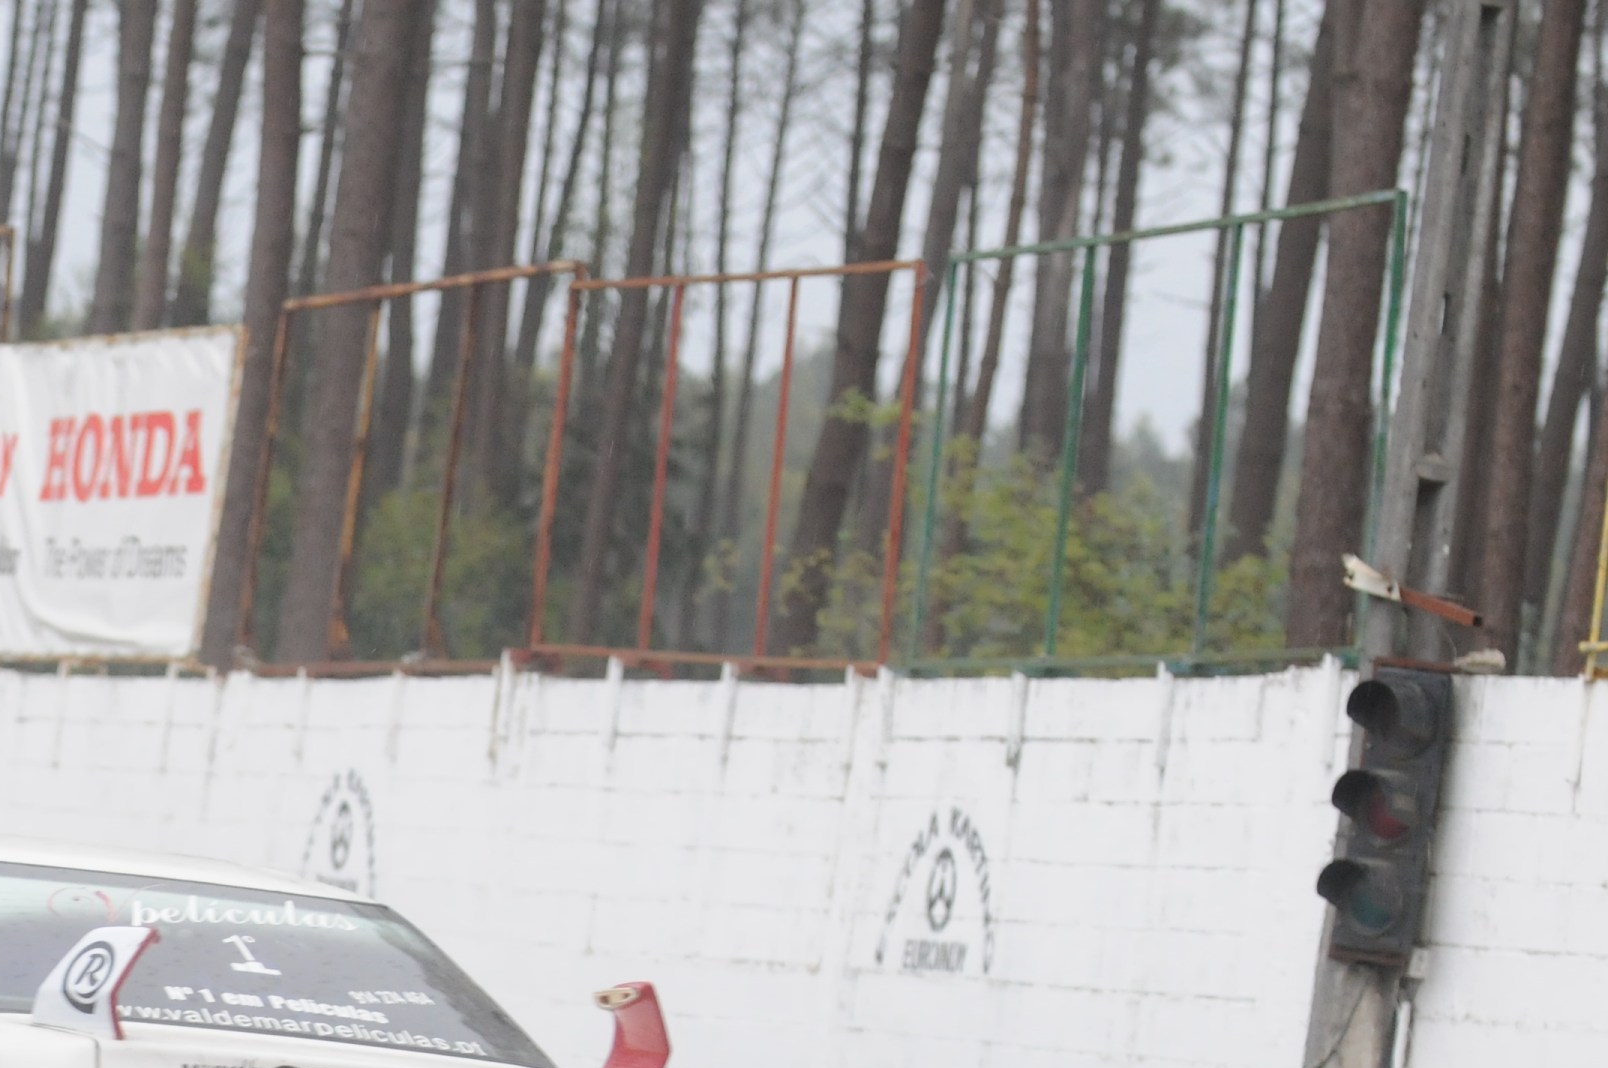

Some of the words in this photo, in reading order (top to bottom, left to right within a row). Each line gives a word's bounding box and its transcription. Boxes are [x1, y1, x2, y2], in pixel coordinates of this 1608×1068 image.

[39, 408, 206, 503] HONDA
[198, 988, 216, 1003] 1
[221, 992, 264, 1007] em
